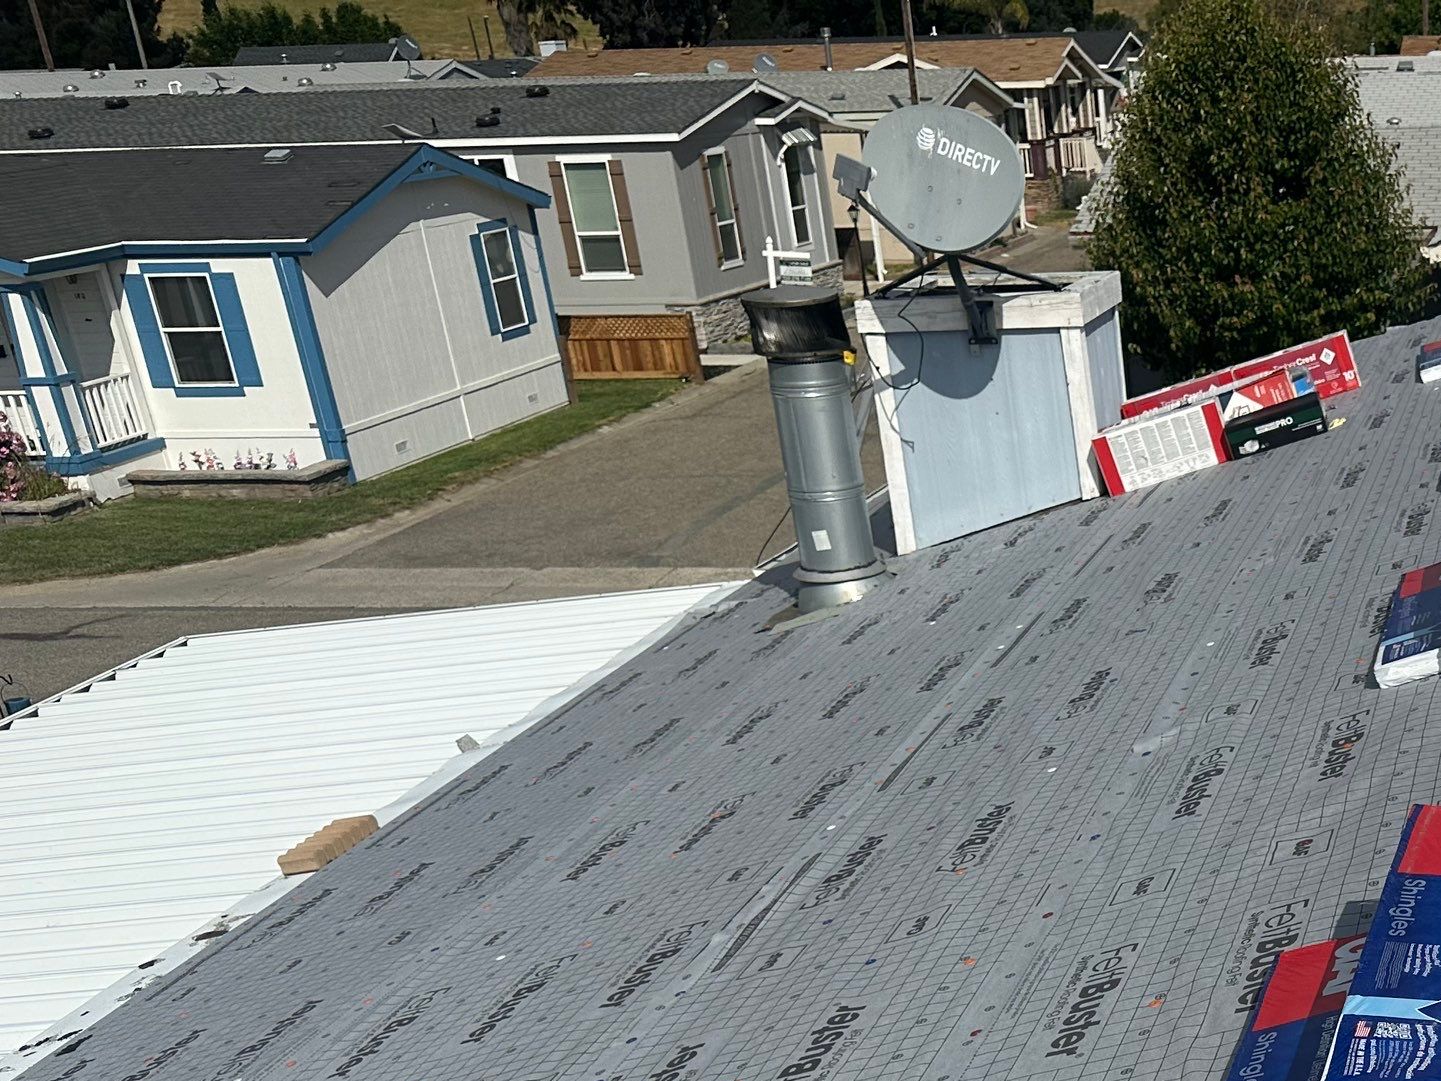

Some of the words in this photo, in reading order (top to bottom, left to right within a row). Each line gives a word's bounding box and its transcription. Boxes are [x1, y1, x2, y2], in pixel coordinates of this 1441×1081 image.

[937, 137, 1000, 176] DIRECTV
[1172, 745, 1235, 821] FeltBuster
[1133, 876, 1155, 897] GAF
[1388, 879, 1426, 937] Shingles
[1045, 943, 1140, 1058] FeltBuster
